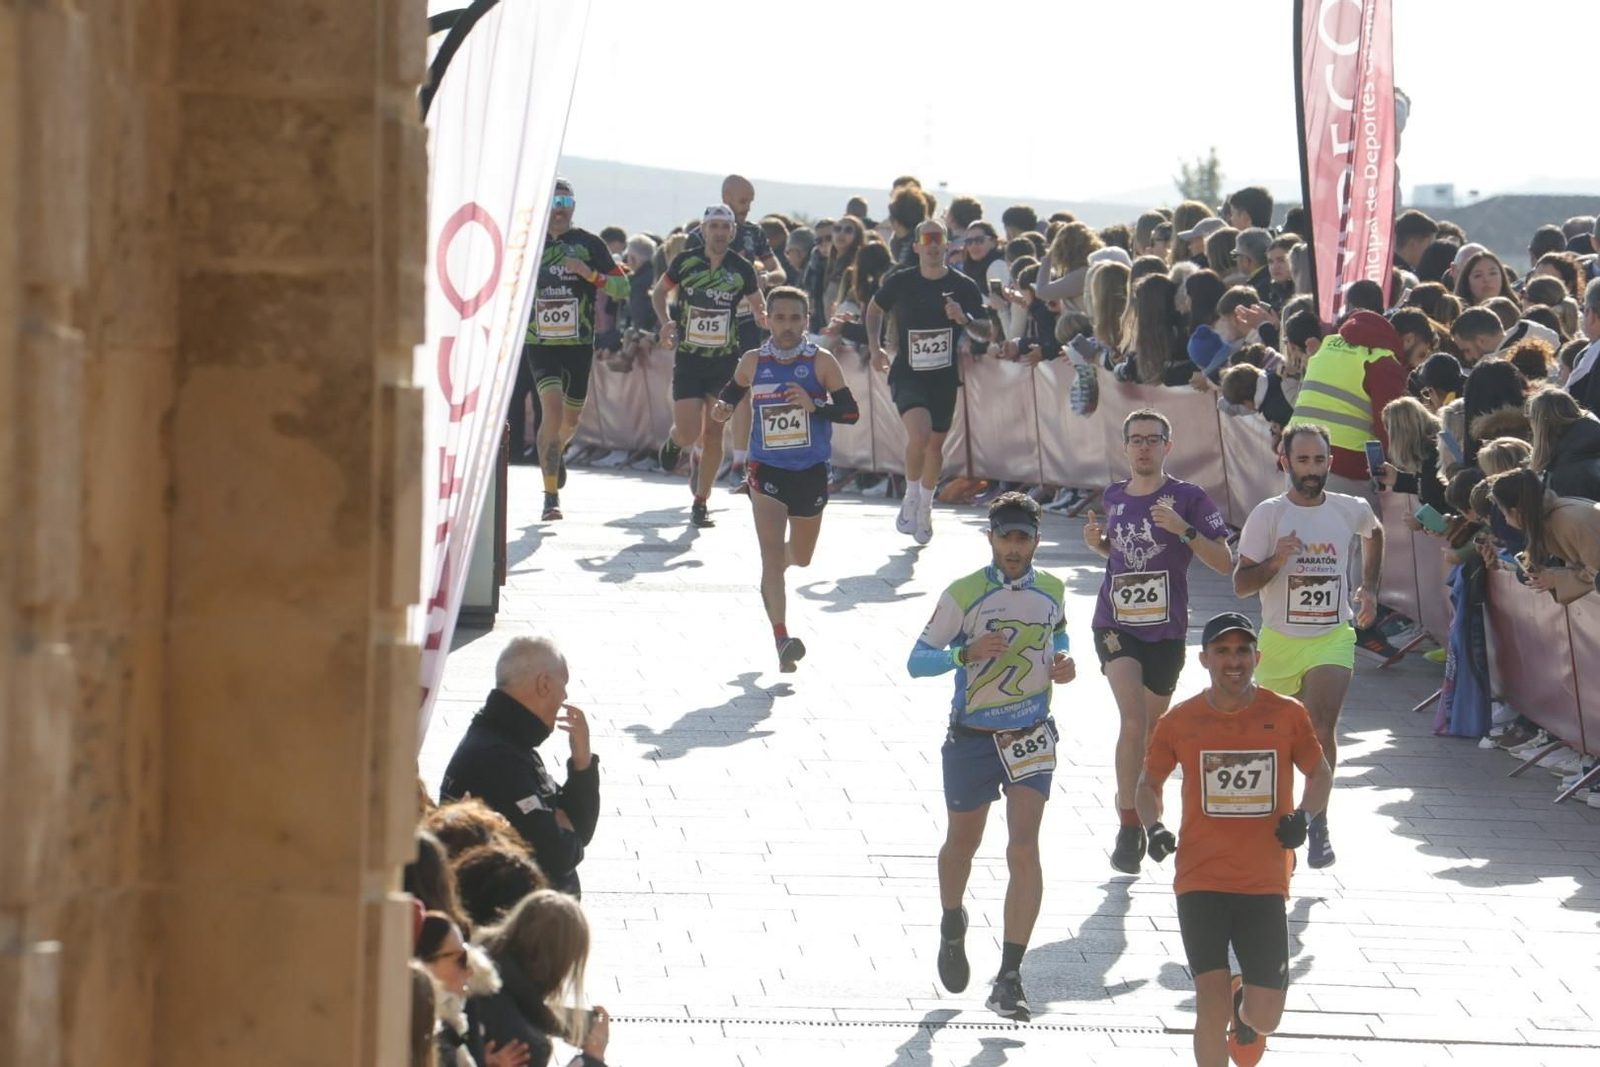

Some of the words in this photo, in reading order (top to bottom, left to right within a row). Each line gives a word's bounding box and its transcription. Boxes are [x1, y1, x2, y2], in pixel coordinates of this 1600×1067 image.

[1360, 81, 1382, 181] Deportes
[1365, 184, 1379, 210] de
[1364, 215, 1383, 283] nicipal
[543, 310, 570, 323] 609
[697, 320, 720, 332] 615
[913, 340, 948, 355] 3423
[768, 415, 800, 431] 704
[1296, 555, 1337, 565] MARATÓN
[1120, 587, 1158, 604] 926
[1300, 590, 1331, 606] 291
[1012, 734, 1049, 759] 889
[1217, 769, 1262, 790] 967
